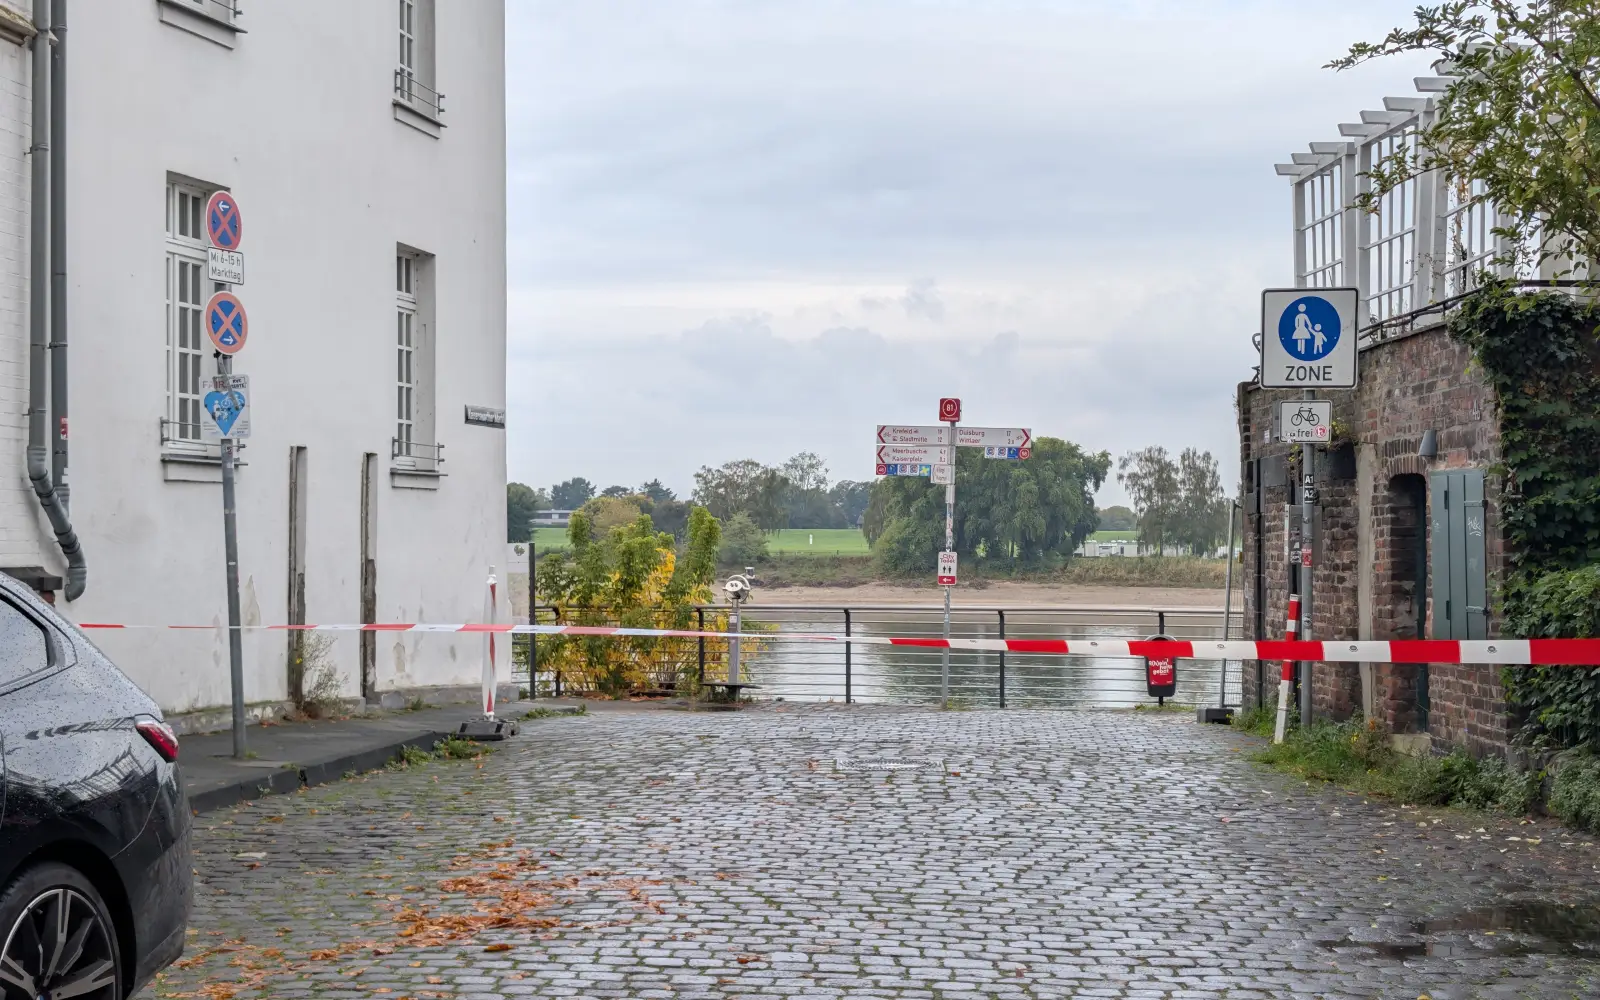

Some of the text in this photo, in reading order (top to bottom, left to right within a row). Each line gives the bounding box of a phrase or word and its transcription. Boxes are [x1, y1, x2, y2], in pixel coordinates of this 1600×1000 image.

[211, 251, 241, 267] Mi 6-15 h
[211, 266, 241, 283] Markttag
[1285, 365, 1333, 381] ZONE
[946, 403, 954, 412] 81
[959, 429, 985, 438] Duisburg
[1297, 428, 1313, 438] frei
[899, 435, 928, 443] Stadtmitte
[892, 447, 923, 455] Meerbusch
[892, 455, 923, 463] Kaiserpfalz
[1304, 475, 1314, 484] A1
[1304, 489, 1314, 499] A2
